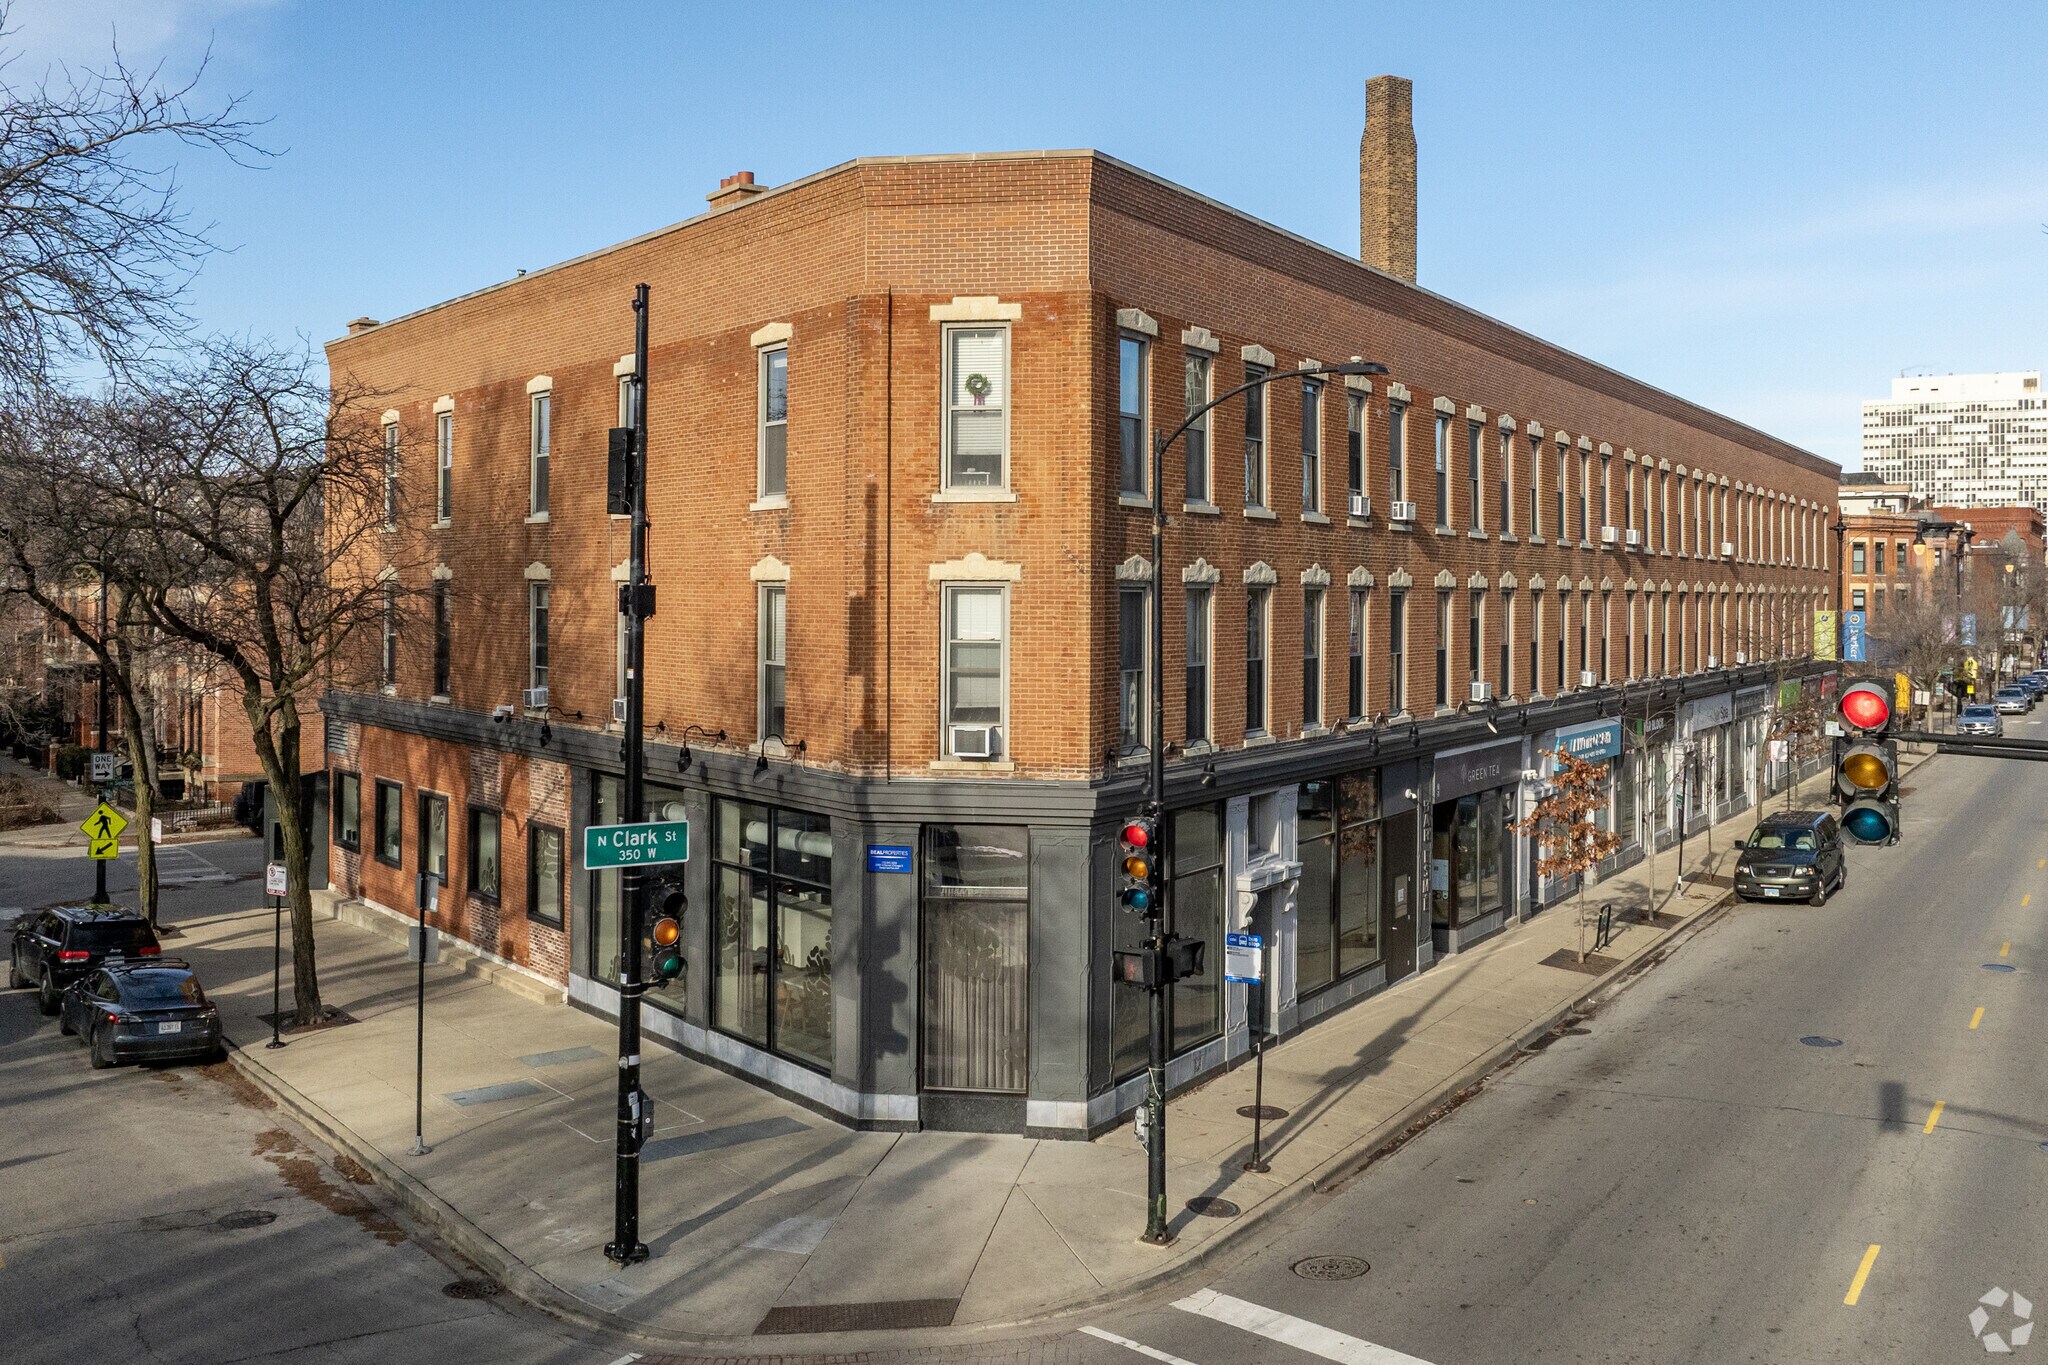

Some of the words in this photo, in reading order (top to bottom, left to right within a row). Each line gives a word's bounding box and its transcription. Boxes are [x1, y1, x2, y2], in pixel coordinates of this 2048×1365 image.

[1468, 767, 1487, 782] GREEN
[1489, 764, 1500, 776] TEA
[1423, 800, 1431, 842] BAR
[598, 836, 606, 846] N
[612, 829, 658, 847] Clark
[665, 830, 676, 842] St
[619, 849, 640, 860] 350
[648, 847, 656, 858] W
